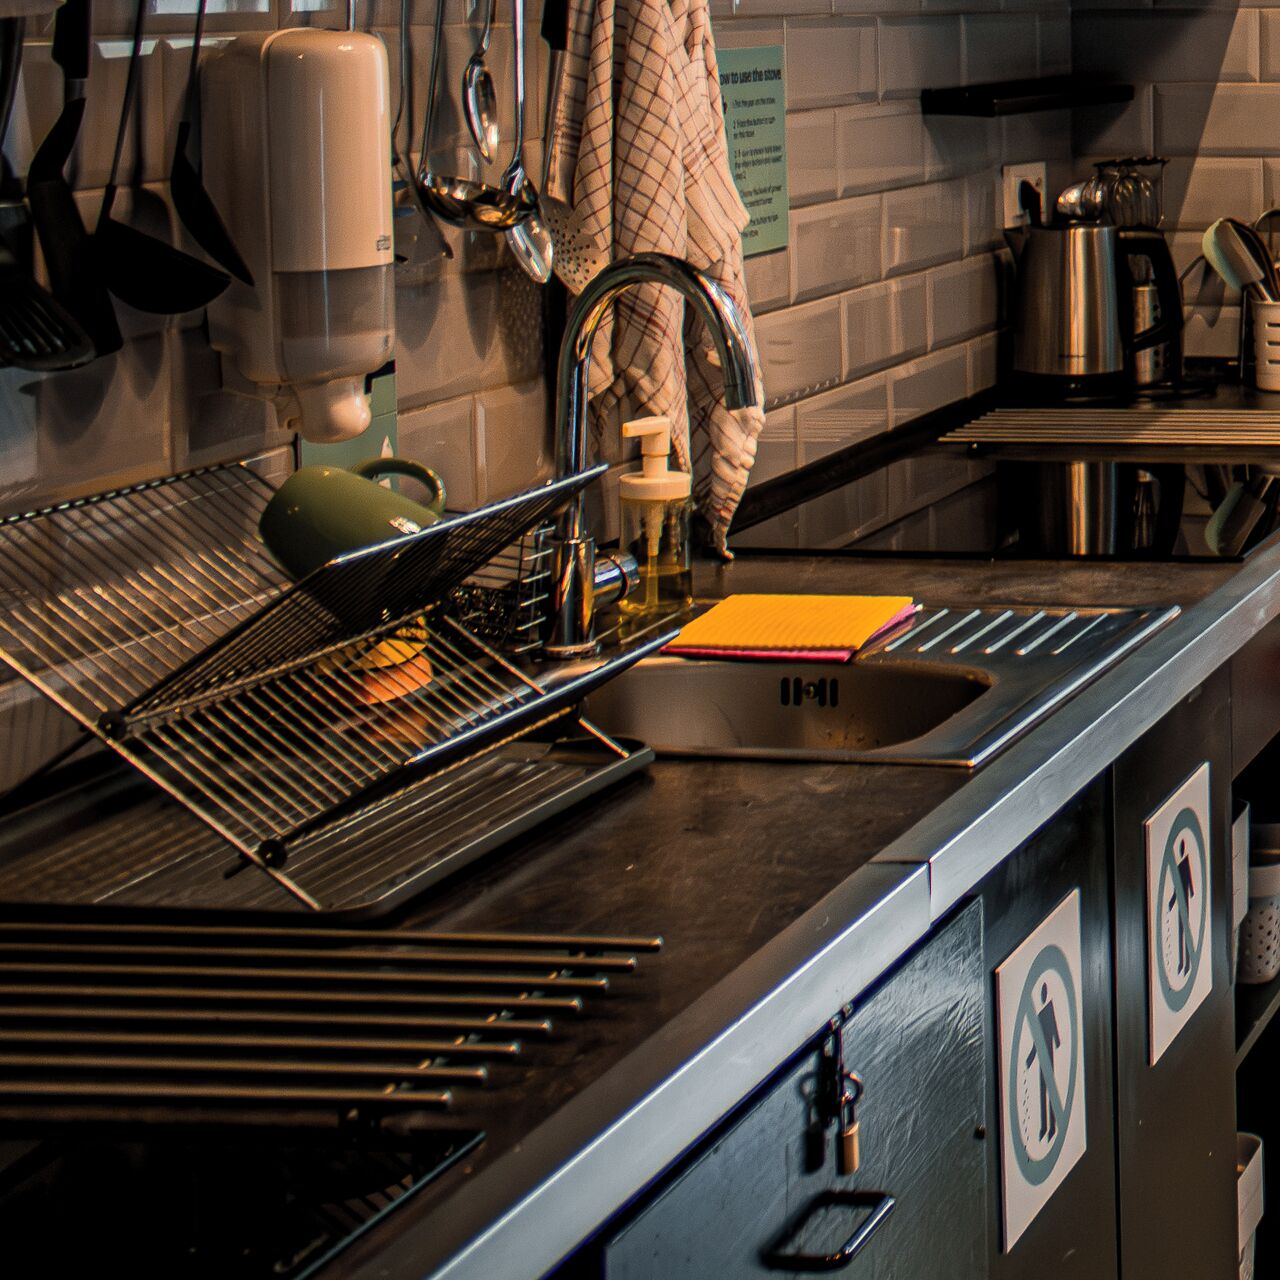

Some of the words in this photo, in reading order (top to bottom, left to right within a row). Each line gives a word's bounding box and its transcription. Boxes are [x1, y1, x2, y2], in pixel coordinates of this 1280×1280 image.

[720, 72, 730, 86] ow
[731, 72, 739, 85] to
[740, 71, 752, 84] use
[752, 67, 764, 82] the
[764, 69, 782, 82] stove
